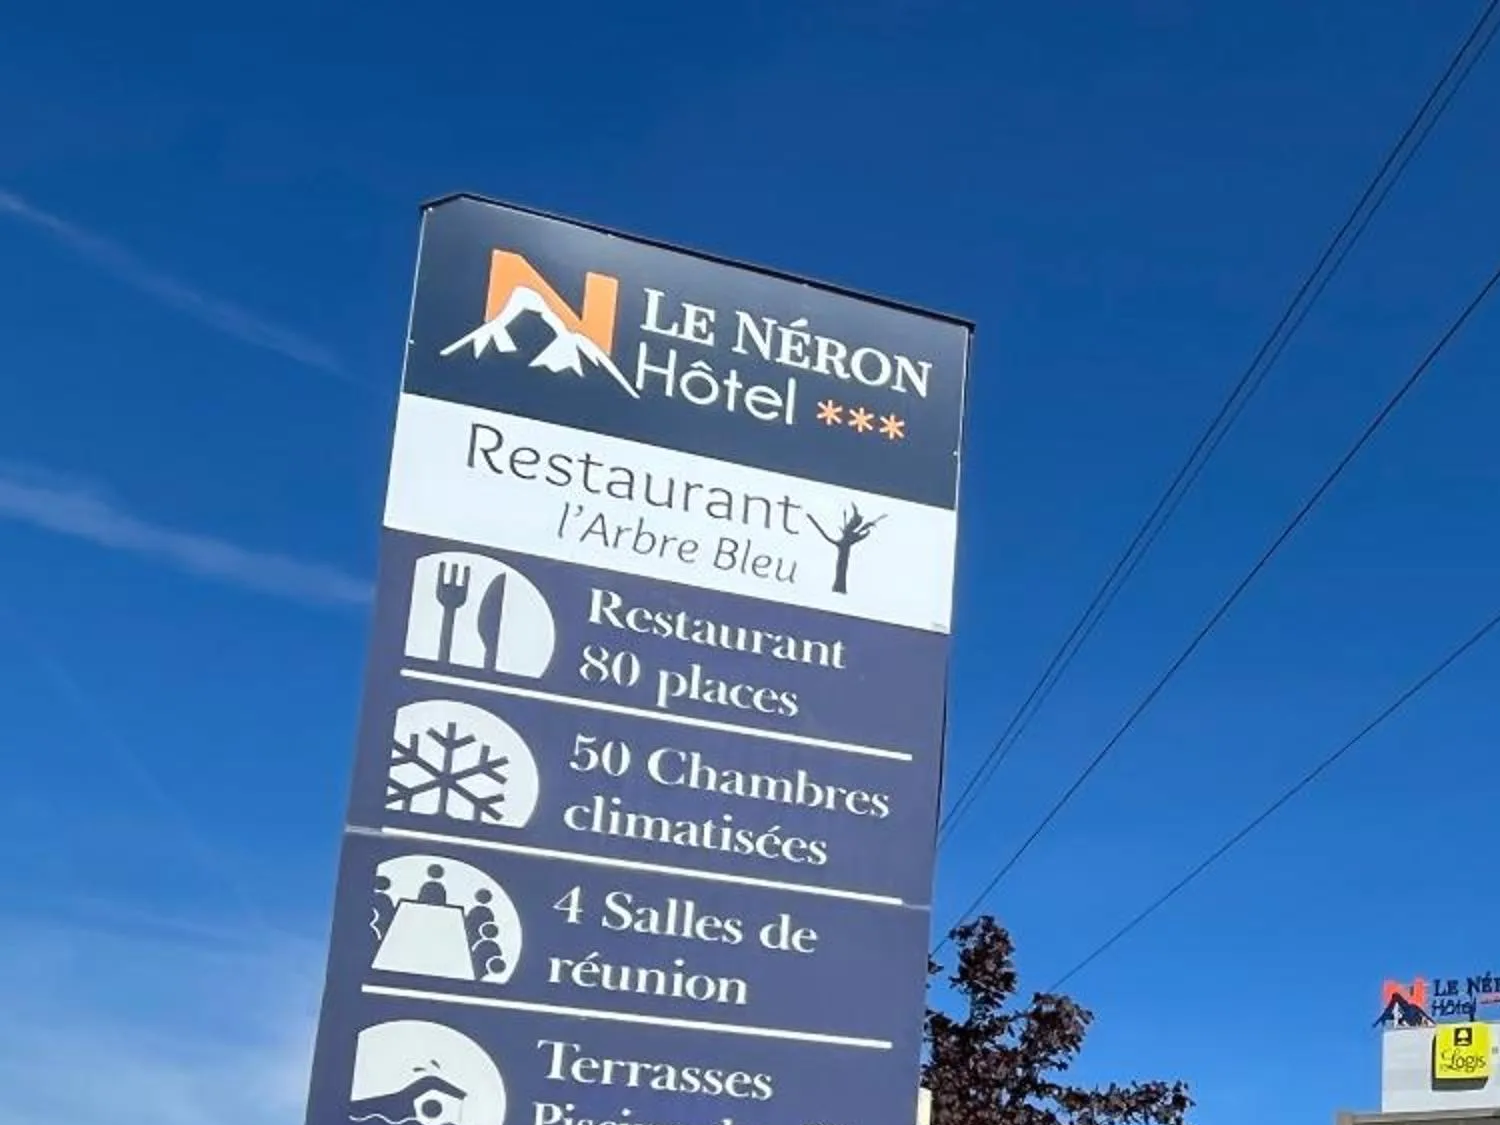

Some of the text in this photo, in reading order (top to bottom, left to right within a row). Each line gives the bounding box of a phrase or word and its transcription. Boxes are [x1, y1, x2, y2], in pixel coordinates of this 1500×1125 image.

[640, 287, 932, 399] LE NÉRON
[635, 342, 797, 425] Hôtel
[466, 423, 800, 536] Restaurant
[557, 502, 797, 584] l'Arbre Bleu
[588, 587, 847, 670] Restaurant
[578, 645, 799, 718] 80 places
[569, 734, 890, 819] 50 Chambres
[562, 796, 828, 866] climatisées
[552, 885, 818, 954] 4 Salles de
[548, 953, 748, 1005] réunion
[1433, 979, 1459, 997] LE
[537, 1039, 774, 1101] Terrasses
[1440, 1048, 1487, 1073] Logis
